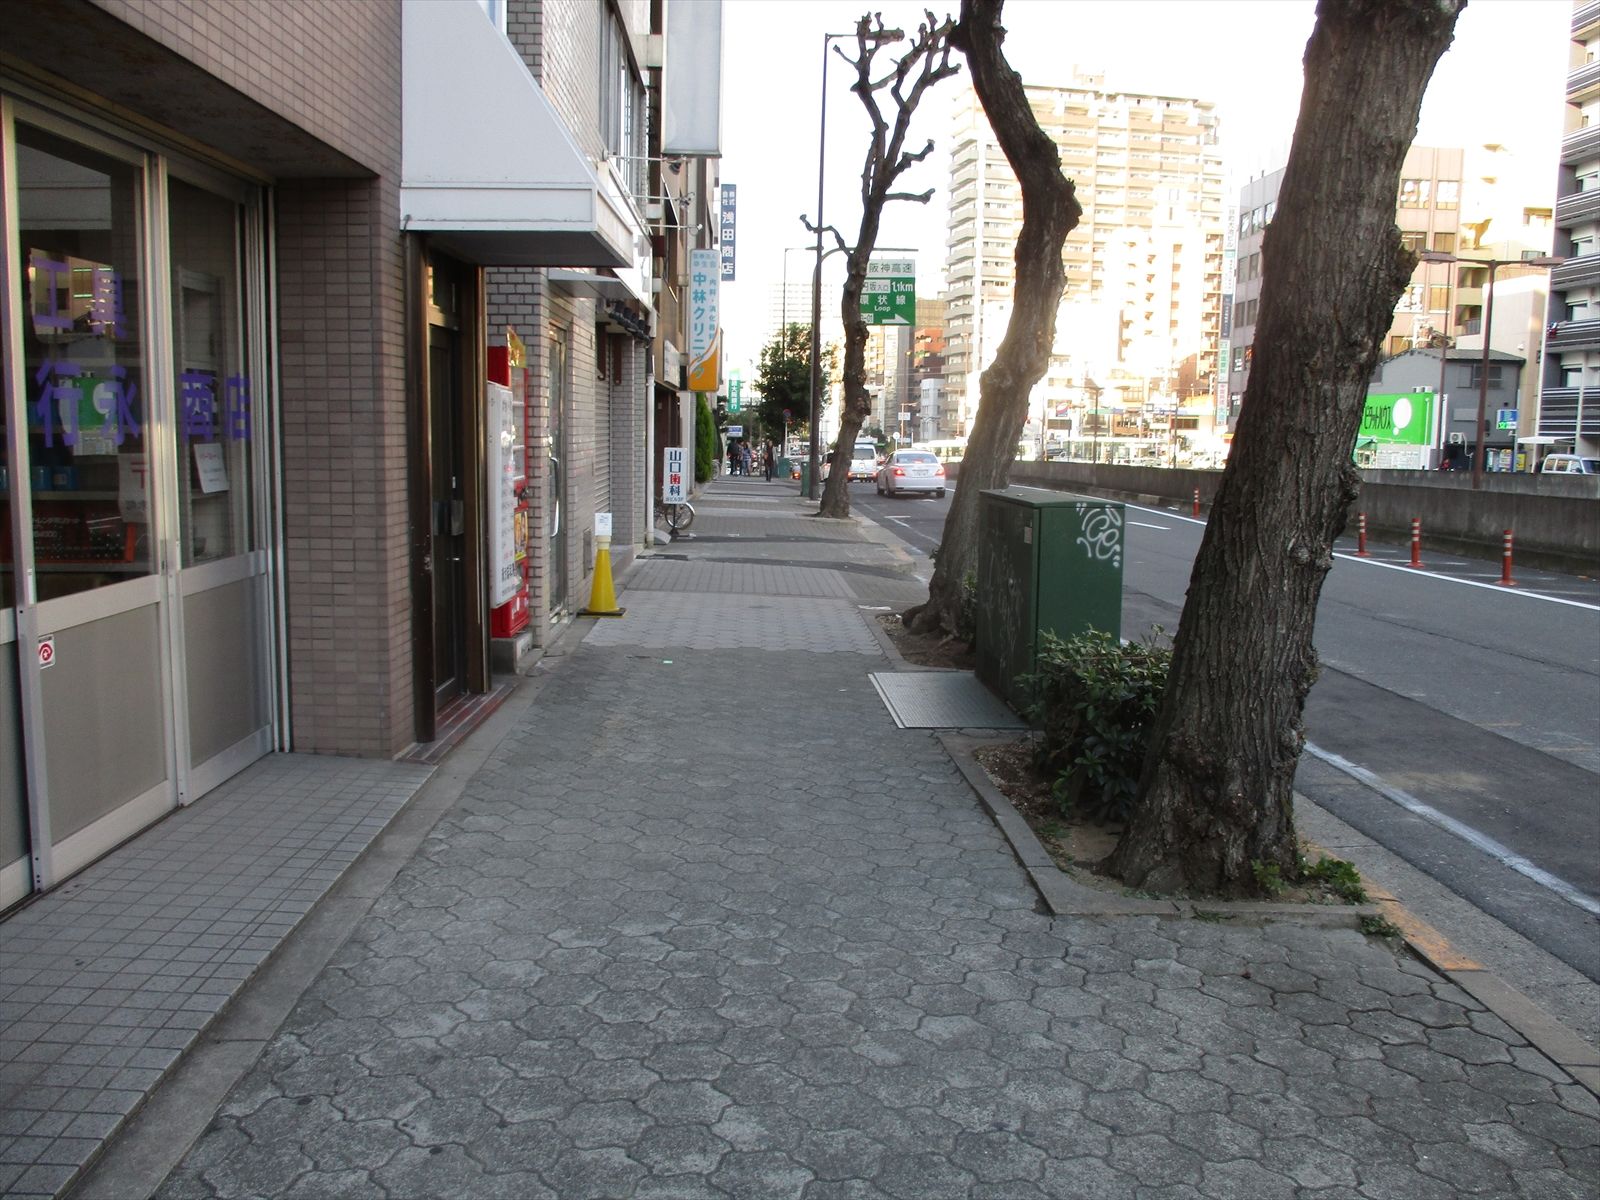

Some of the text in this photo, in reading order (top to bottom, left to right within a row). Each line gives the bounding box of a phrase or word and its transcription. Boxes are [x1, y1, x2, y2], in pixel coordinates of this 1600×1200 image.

[721, 211, 735, 275] 浅田商店
[869, 263, 912, 273] 阪神高速
[692, 272, 707, 380] 中林クリニック
[669, 450, 682, 496] 山口歯科
